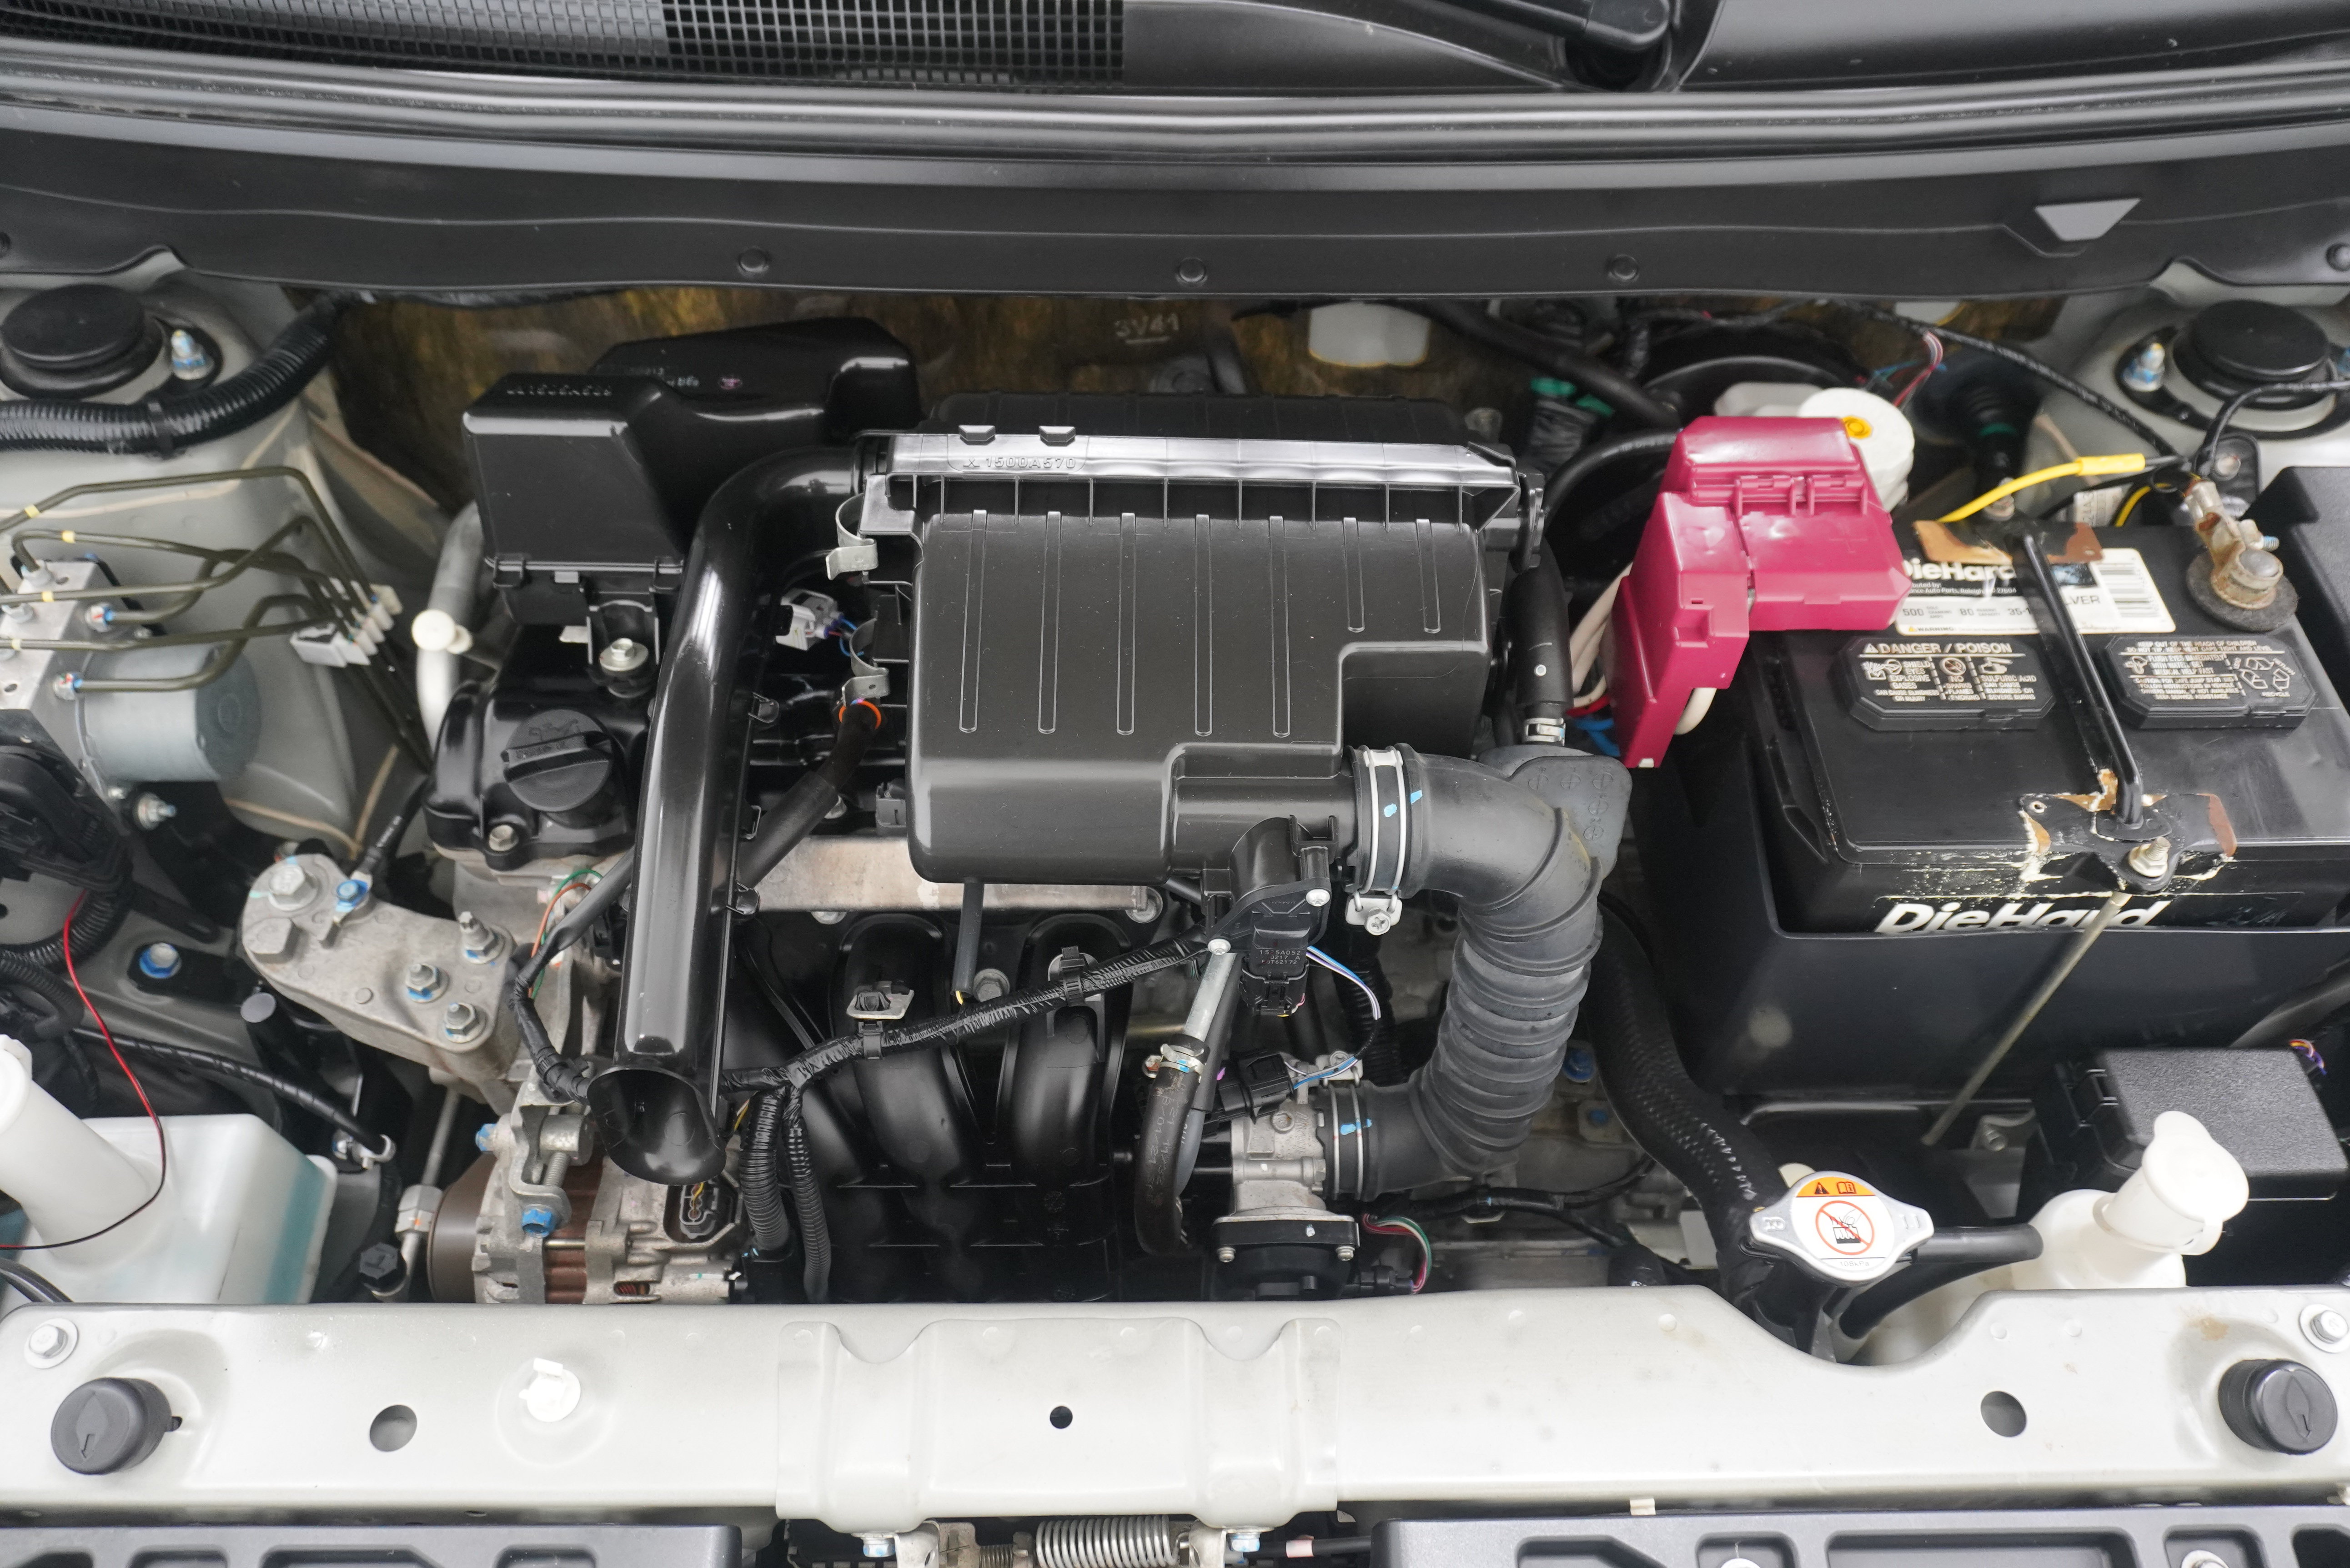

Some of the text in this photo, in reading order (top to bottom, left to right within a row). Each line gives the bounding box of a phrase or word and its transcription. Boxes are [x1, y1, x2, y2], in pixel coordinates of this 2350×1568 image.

[986, 456, 1076, 469] 1500A570
[1903, 608, 1924, 616] 500
[1878, 643, 1942, 653] DANGER
[1954, 643, 2013, 653] POISON
